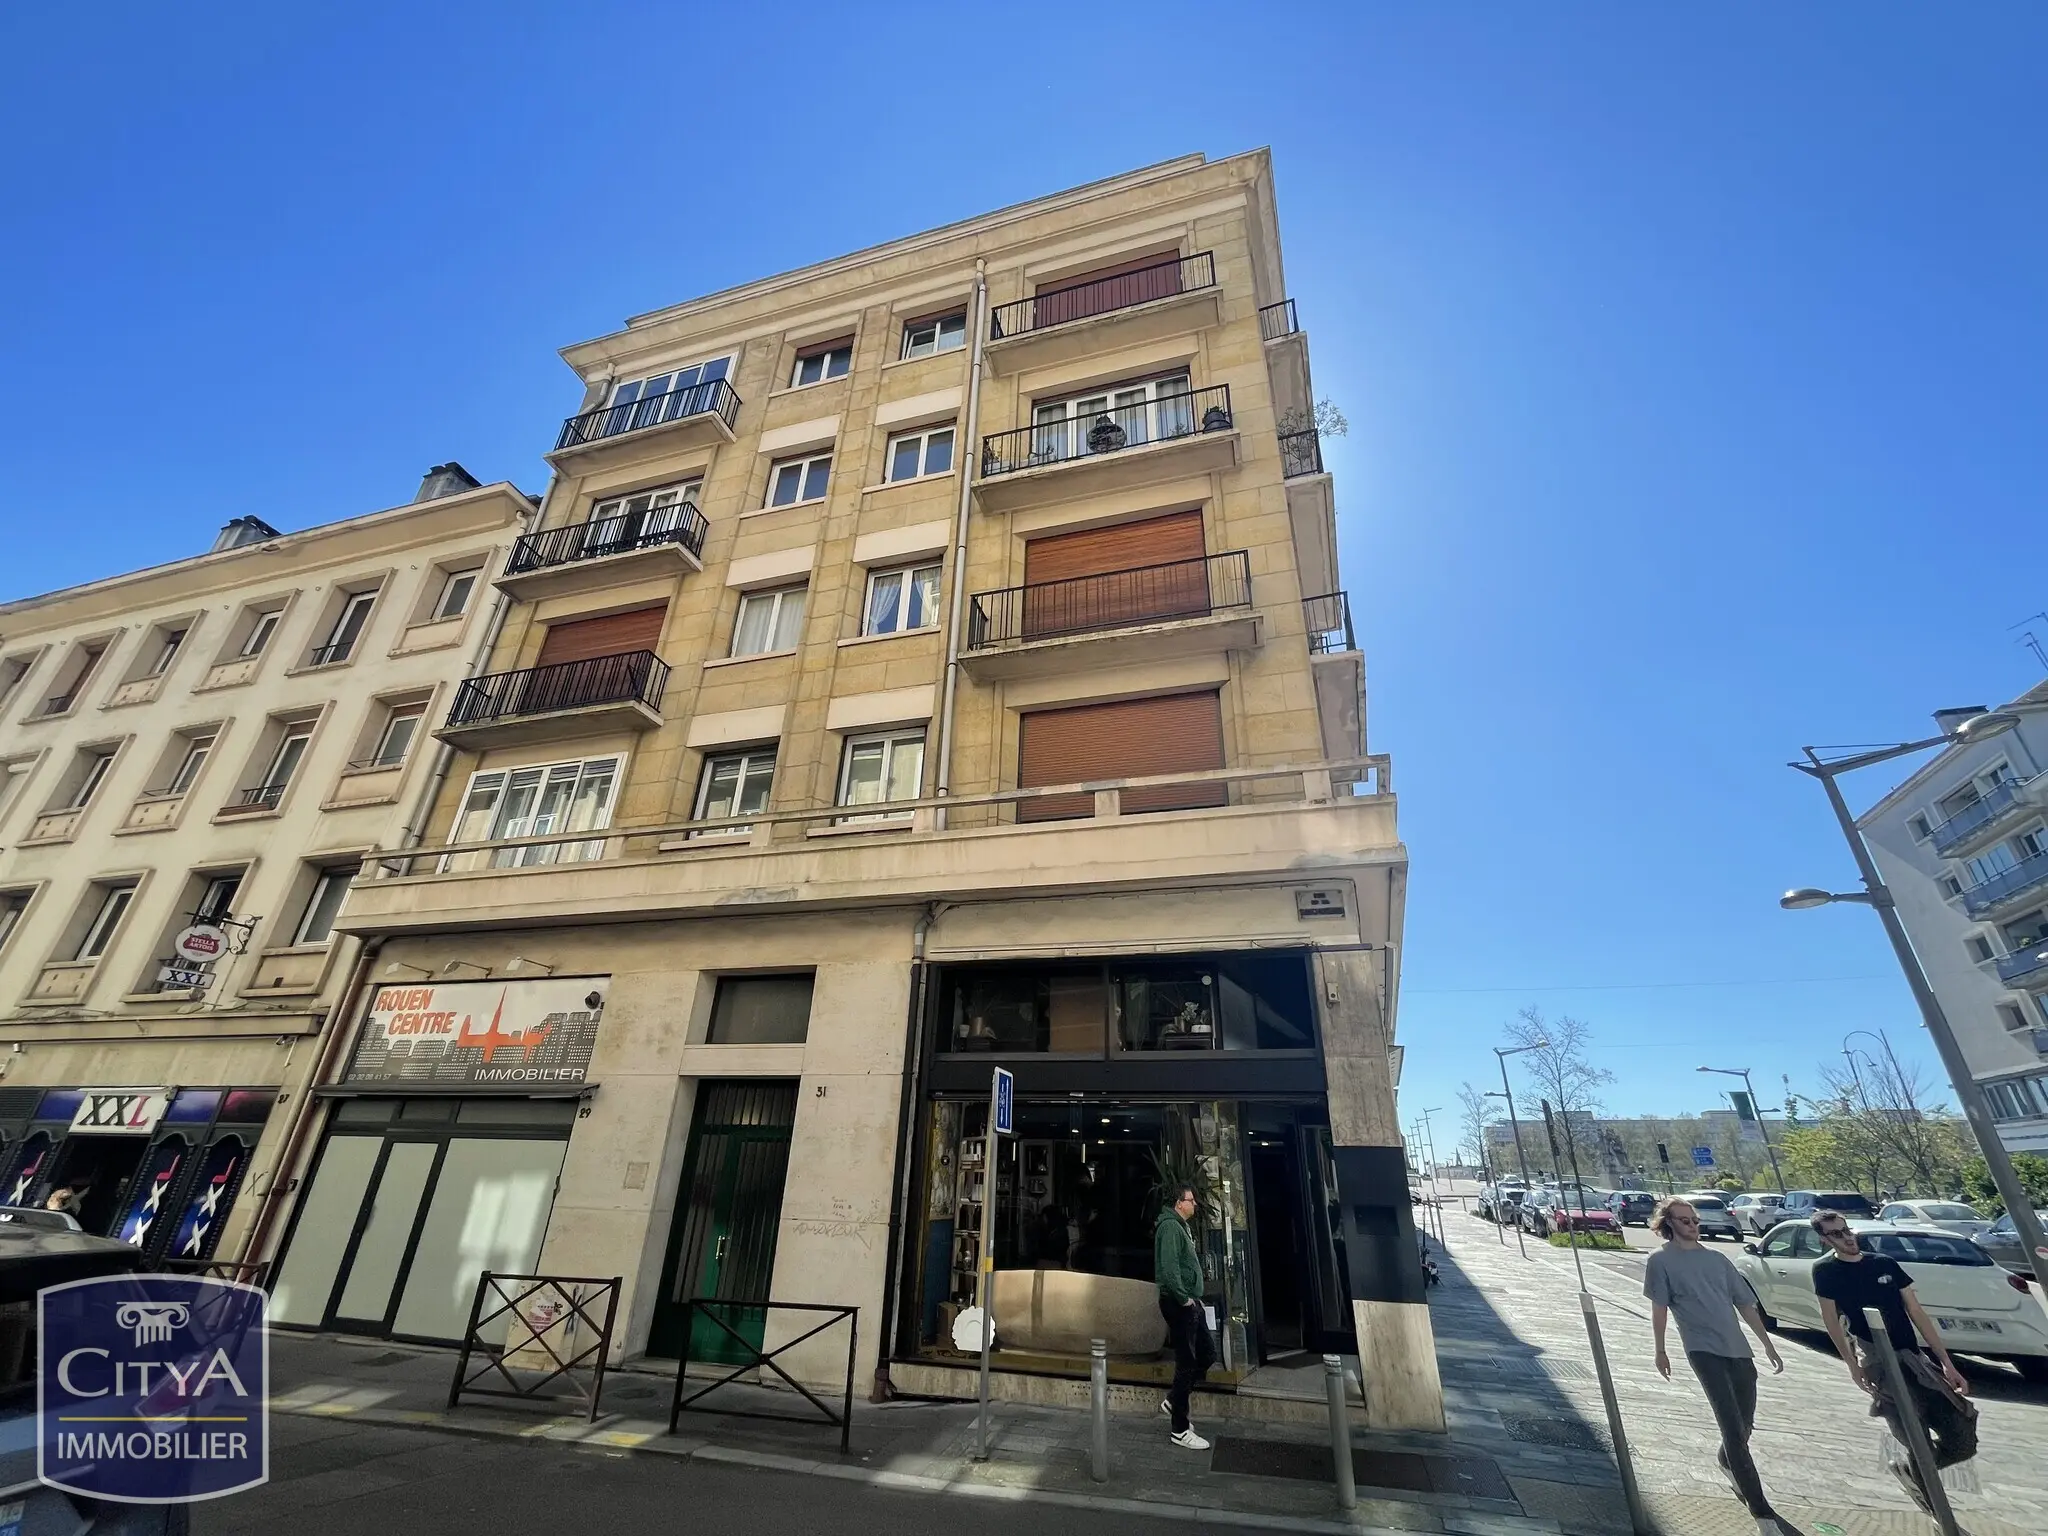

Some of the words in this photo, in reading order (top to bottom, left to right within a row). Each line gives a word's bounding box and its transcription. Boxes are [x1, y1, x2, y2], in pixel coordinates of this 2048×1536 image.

[188, 942, 214, 951] ARTOIS
[191, 937, 215, 946] STELLA
[166, 970, 205, 986] XXL
[375, 989, 434, 1012] ROUEN
[388, 1011, 457, 1035] CENTRE
[474, 1068, 585, 1082] IMMOBILIER
[278, 1093, 290, 1104] 27
[815, 1086, 827, 1098] 31
[77, 1095, 151, 1127] XXL
[578, 1107, 592, 1119] 29
